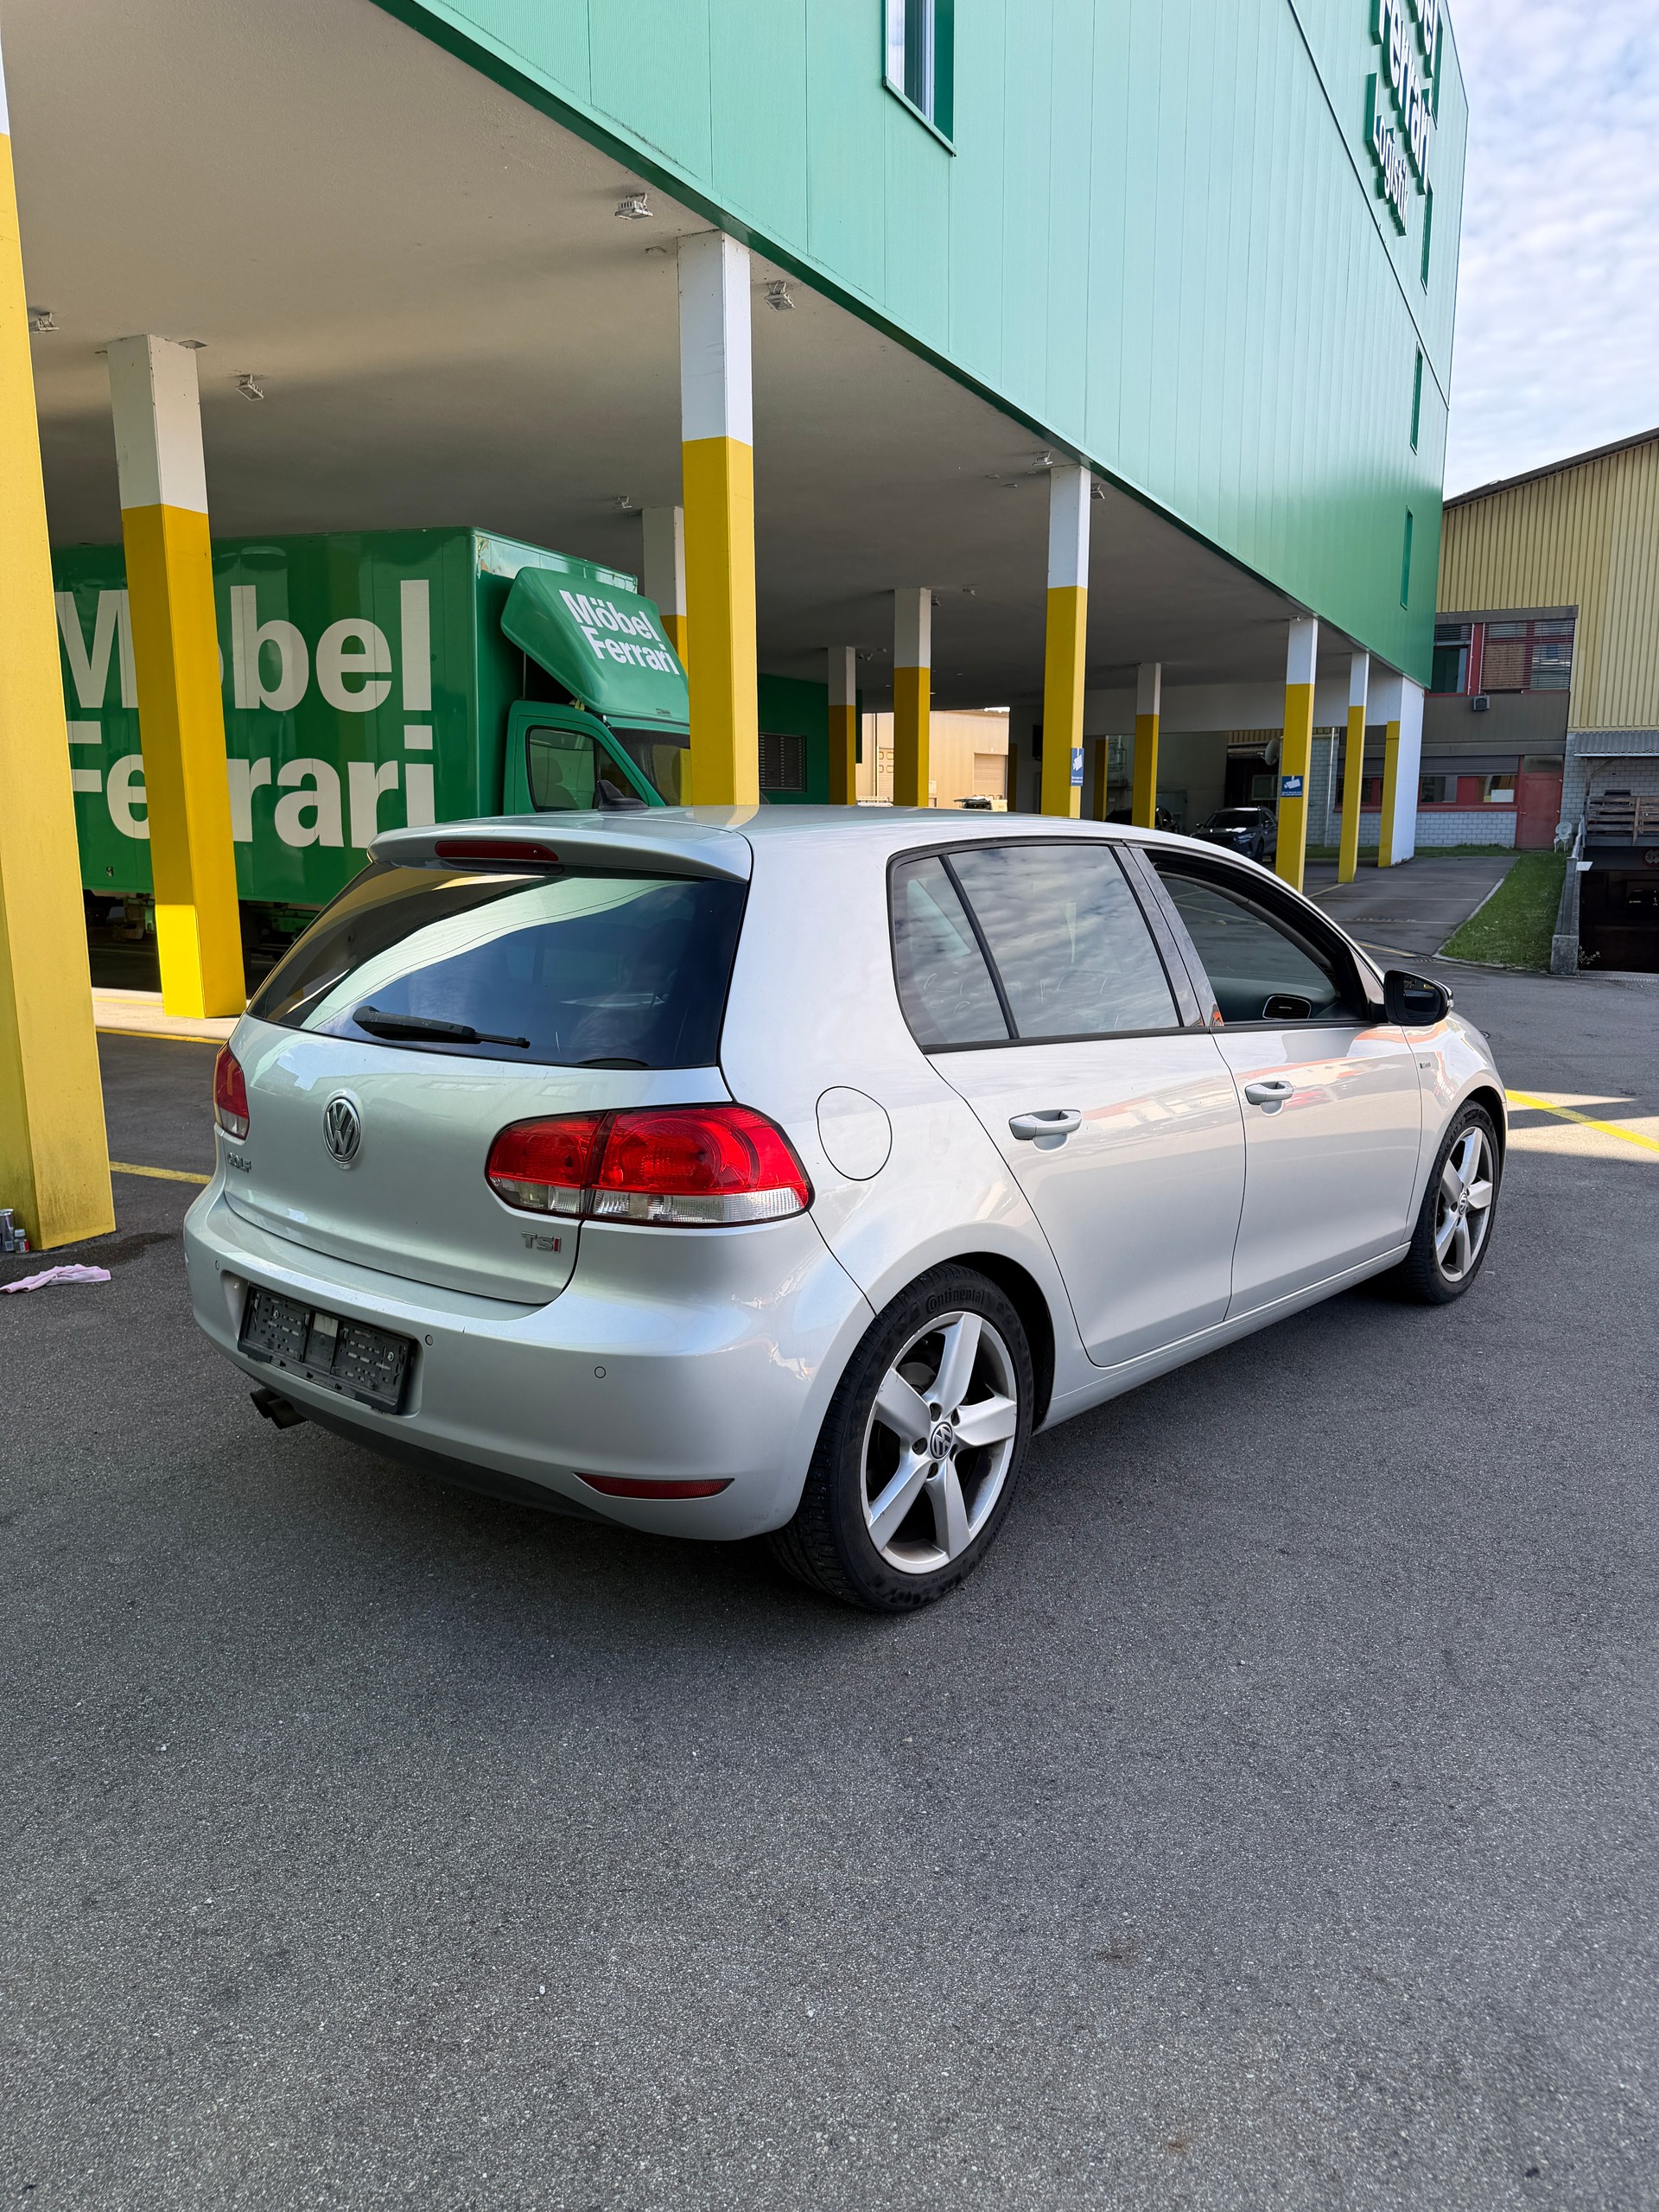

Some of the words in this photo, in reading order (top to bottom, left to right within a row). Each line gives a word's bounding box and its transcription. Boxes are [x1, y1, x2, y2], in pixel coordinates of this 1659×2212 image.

[559, 589, 661, 641] Möbel
[54, 580, 432, 713] Mbel
[581, 625, 680, 675] Ferrari
[67, 721, 435, 849] erari
[227, 1151, 251, 1173] GOLF
[521, 1230, 561, 1253] TSI
[925, 1287, 985, 1313] Continental
